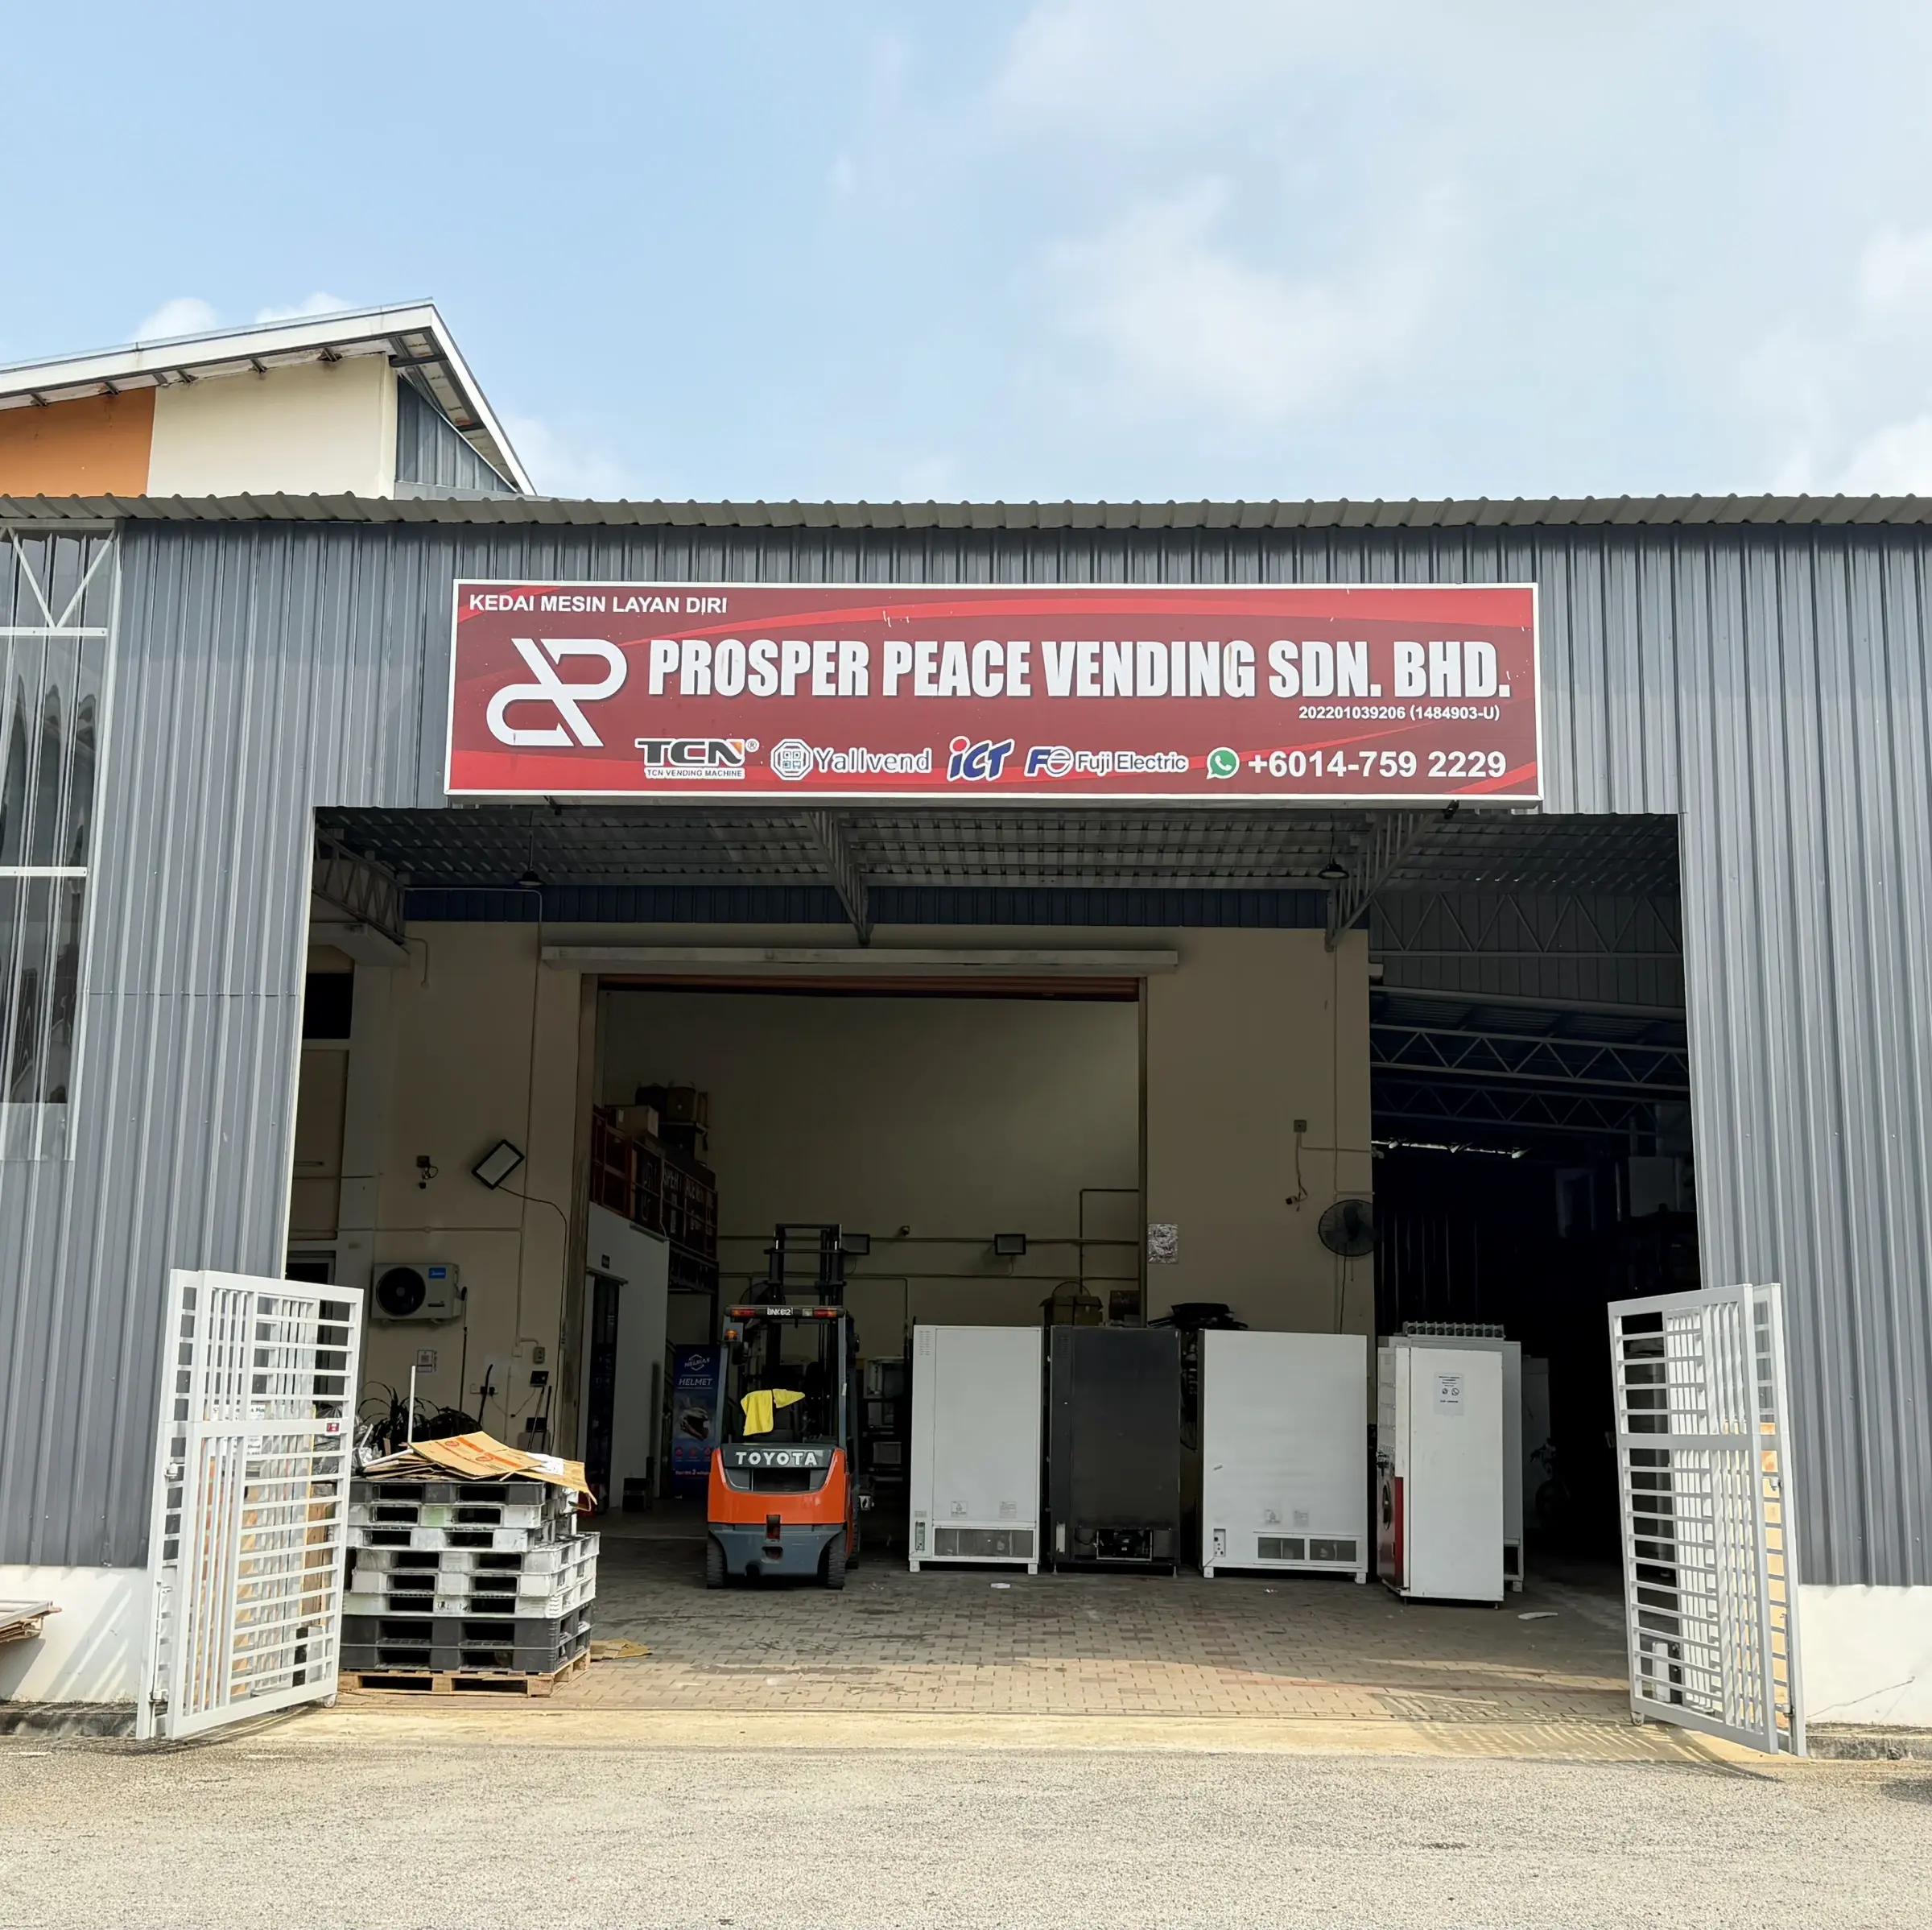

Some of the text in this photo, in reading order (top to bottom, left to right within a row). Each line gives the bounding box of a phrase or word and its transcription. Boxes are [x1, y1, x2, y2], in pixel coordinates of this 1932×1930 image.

[470, 595, 728, 614] KEDAI MESIN LAYAN DIRI
[649, 639, 1511, 698] PROSPER PEACE VENDING SDN. BHD.
[1298, 705, 1500, 721] 202201039206 (1484903-U)
[815, 749, 931, 771] Yallvend
[1078, 754, 1111, 774] Fuji
[1117, 754, 1187, 771] Electric
[1249, 750, 1506, 778] +6014-759 2229
[647, 769, 743, 778] TCN VENDING MACHINE
[678, 1378, 713, 1386] HELMET
[736, 1452, 817, 1465] TOYOTA
